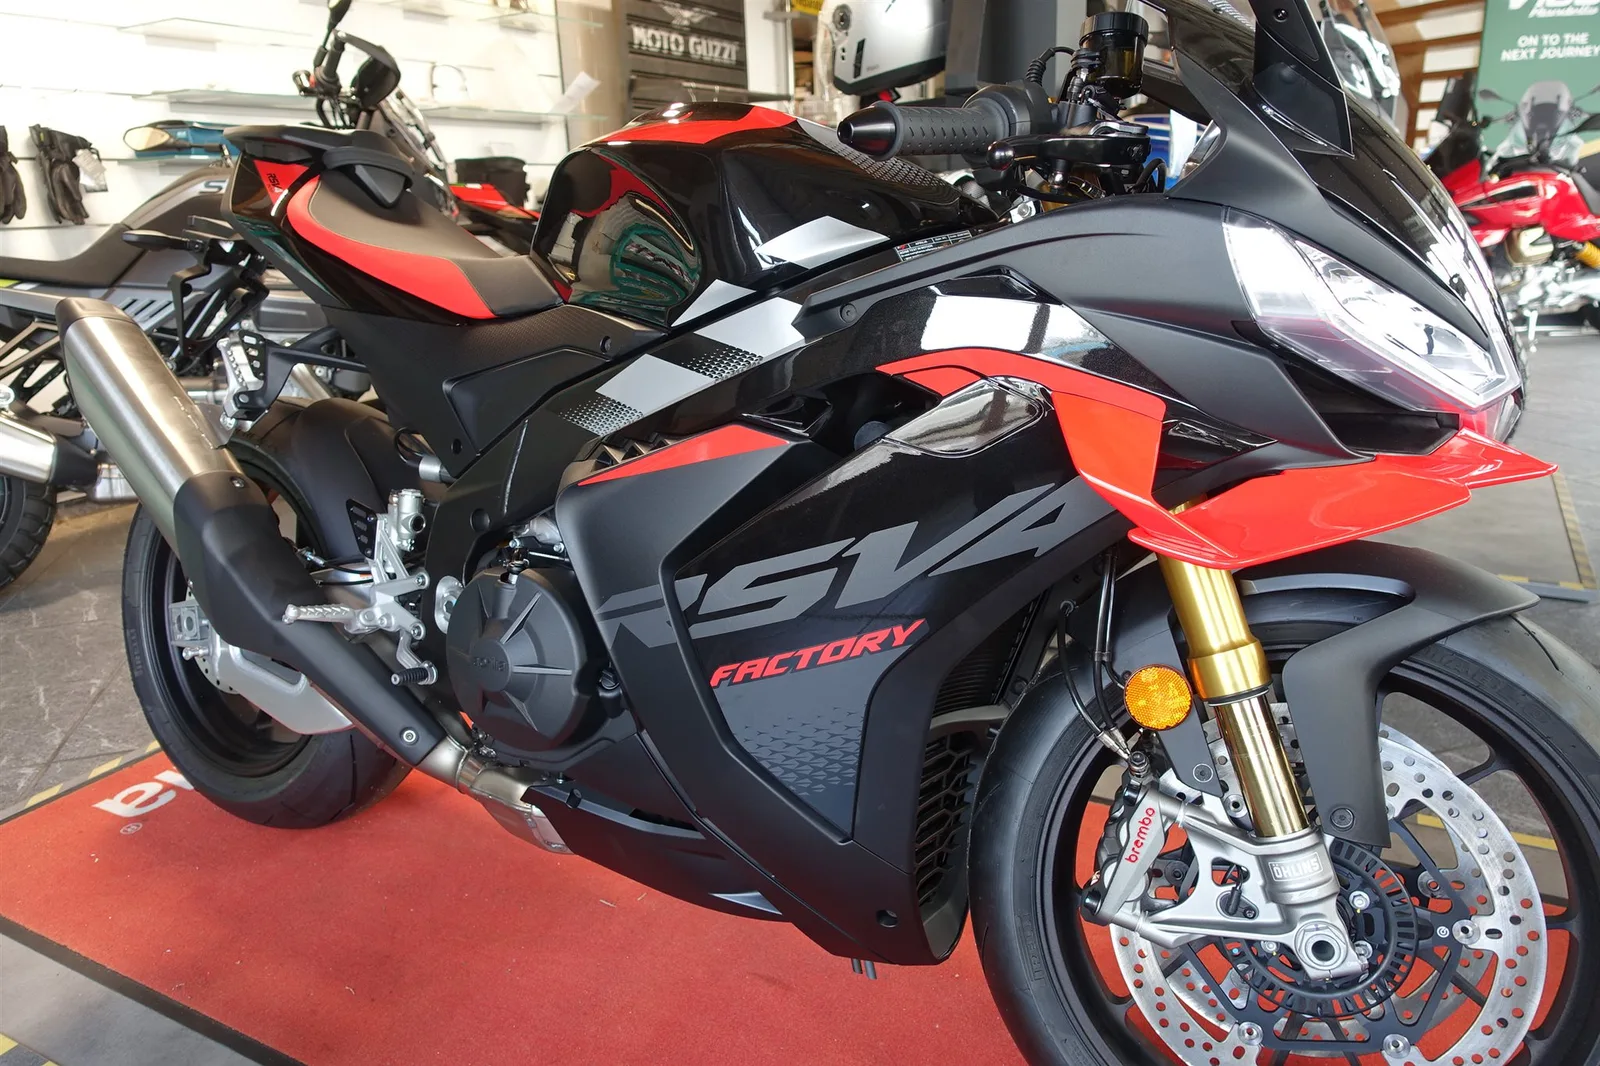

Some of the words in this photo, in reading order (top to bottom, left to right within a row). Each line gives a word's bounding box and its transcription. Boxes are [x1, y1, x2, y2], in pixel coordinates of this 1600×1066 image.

[631, 25, 685, 56] MOTO
[688, 36, 739, 65] GUZZI
[1500, 47, 1537, 62] NEXT
[1539, 45, 1600, 60] JOURNEY
[1517, 35, 1539, 48] ON
[1542, 33, 1560, 46] TO
[1563, 32, 1589, 45] THE
[594, 476, 1114, 648] RSV4
[709, 618, 927, 688] FACTORY
[1125, 807, 1155, 863] brembo
[1272, 857, 1320, 878] ÖHLINS
